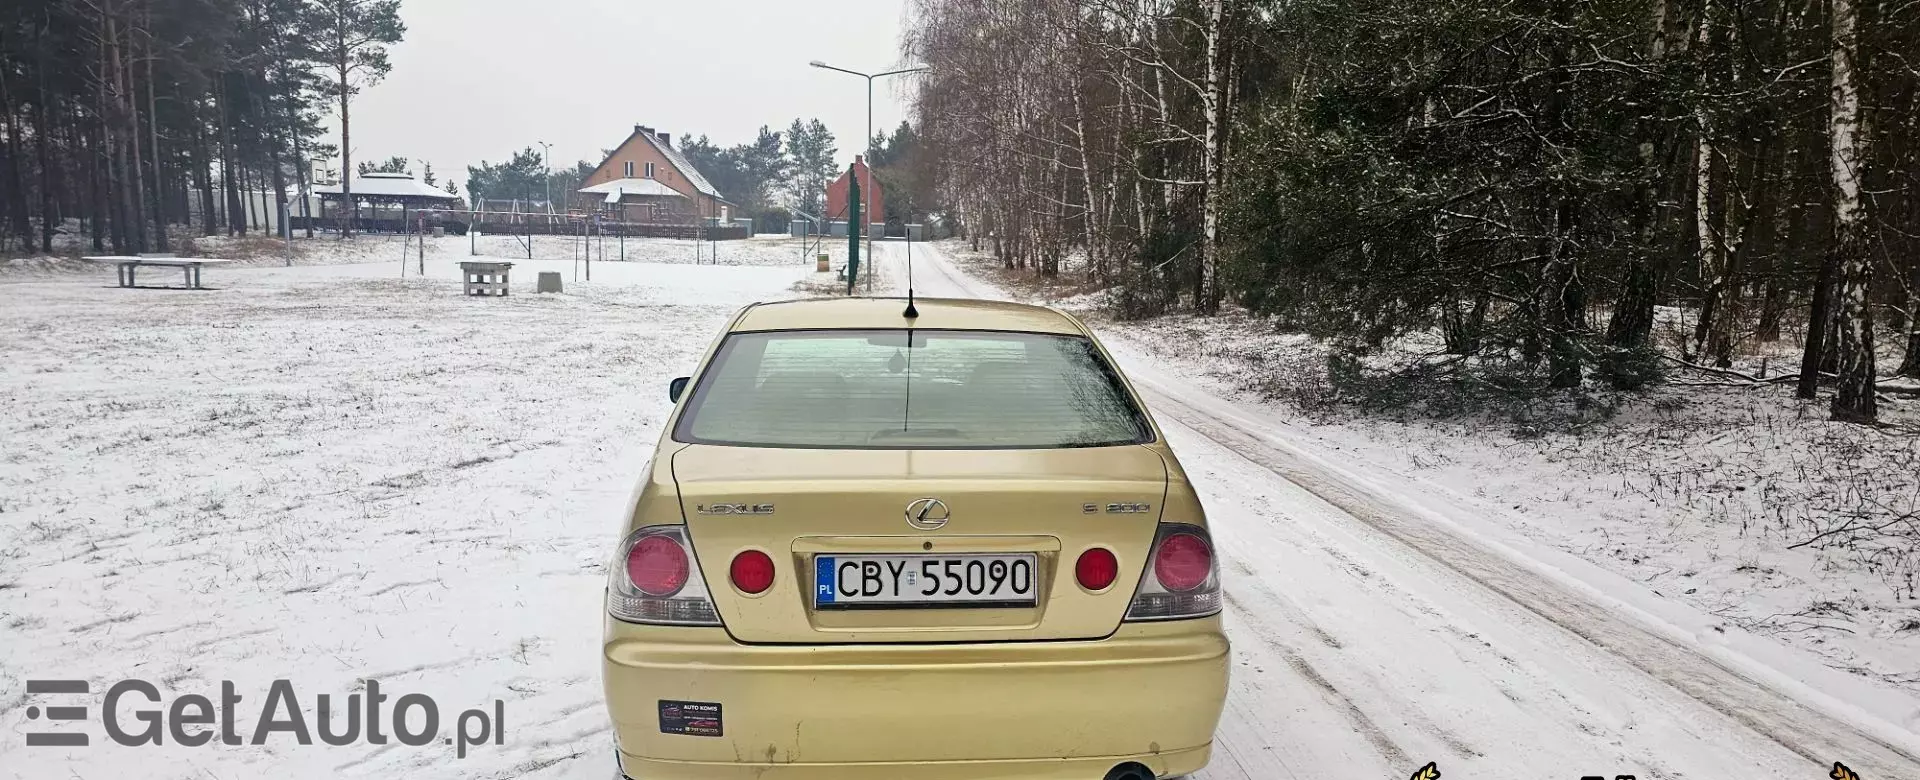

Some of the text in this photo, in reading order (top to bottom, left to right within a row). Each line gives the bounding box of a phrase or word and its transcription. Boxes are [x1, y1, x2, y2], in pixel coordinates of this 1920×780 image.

[697, 503, 775, 515] LEXUS
[838, 559, 1031, 598] CBY 55090
[819, 584, 832, 595] PL
